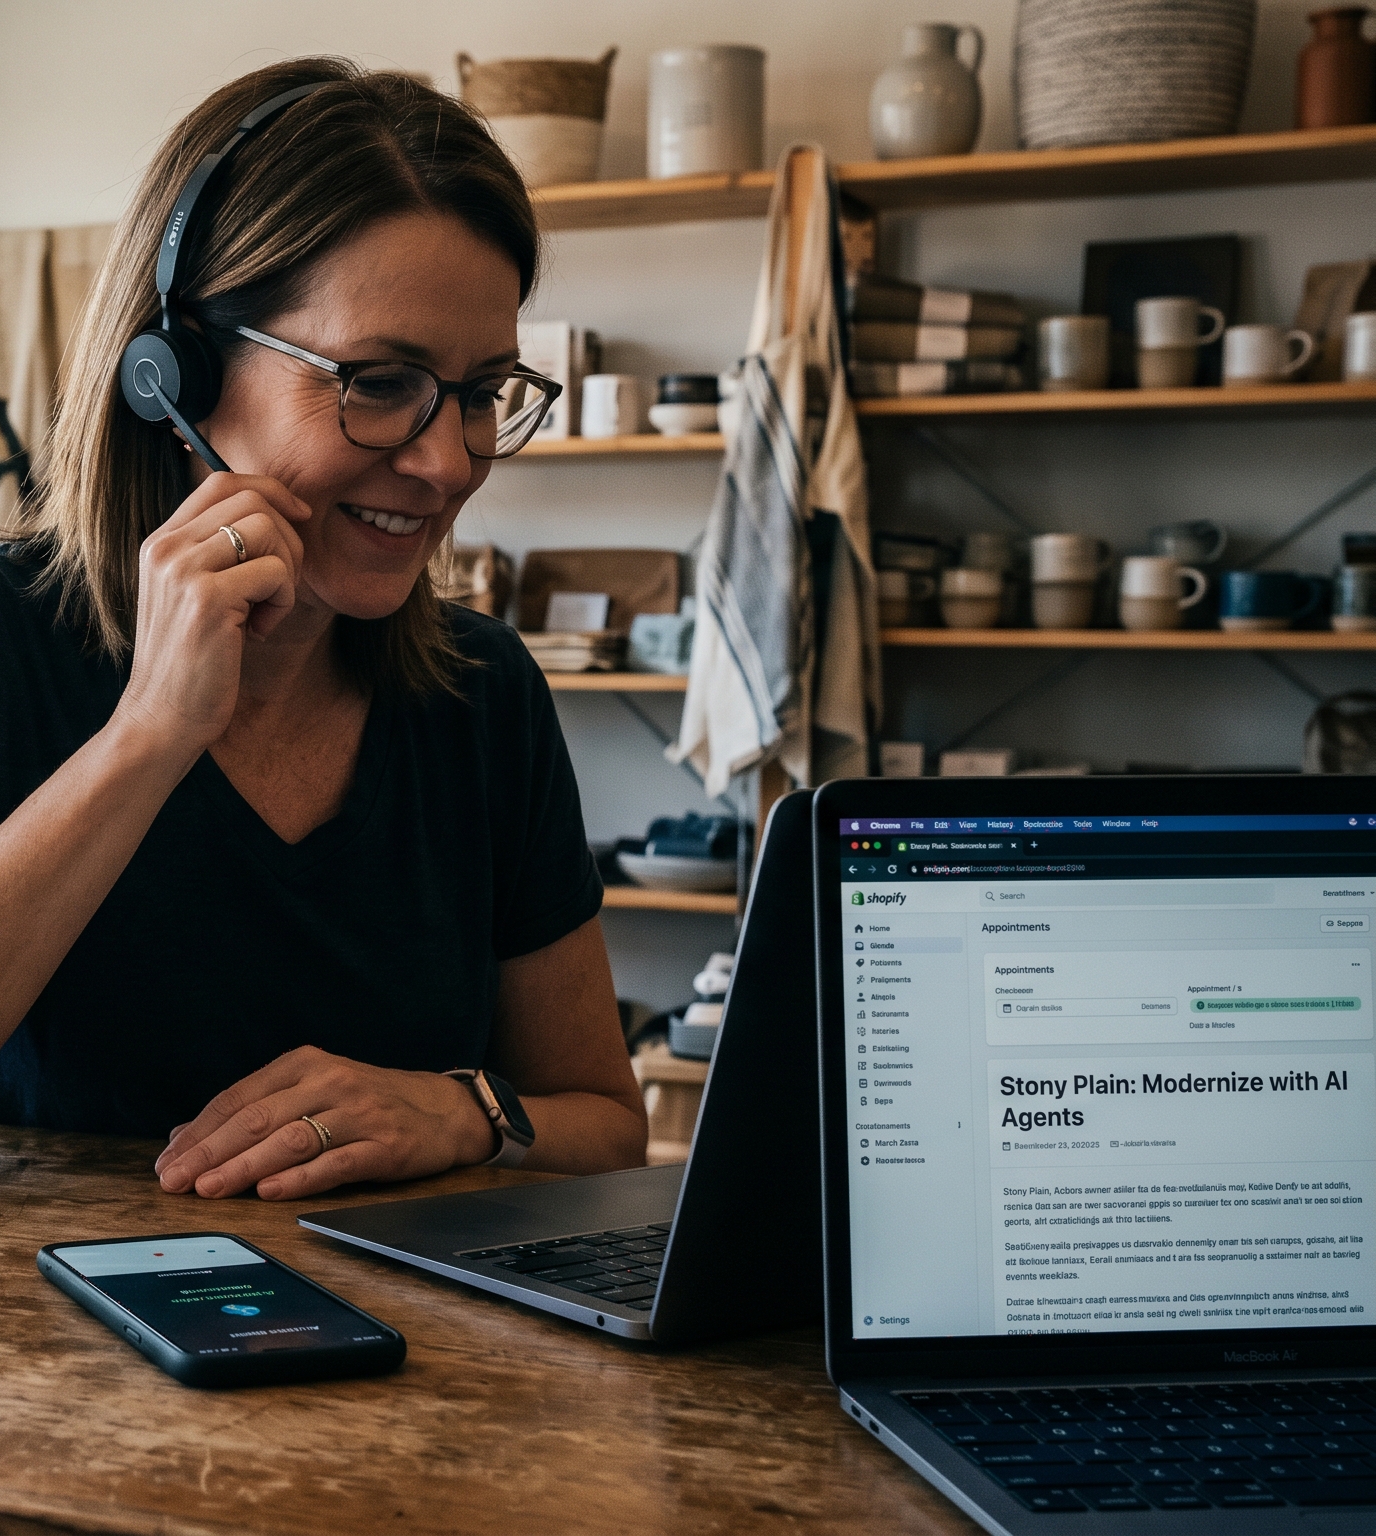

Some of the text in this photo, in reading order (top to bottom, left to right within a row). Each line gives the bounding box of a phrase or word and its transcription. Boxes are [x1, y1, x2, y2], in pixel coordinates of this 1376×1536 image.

[867, 892, 906, 905] shopify
[1000, 892, 1025, 900] Search
[982, 922, 1050, 933] Appointments
[995, 966, 1054, 975] Appointments
[1188, 985, 1231, 993] Appointment
[1000, 1070, 1348, 1099] Stony Plain: Modernize with AI
[1002, 1107, 1084, 1131] Agents
[1058, 1142, 1070, 1150] 23,
[1071, 1141, 1100, 1149] 202025
[1003, 1187, 1027, 1197] Stony
[1069, 1202, 1083, 1210] are
[1155, 1254, 1171, 1263] and
[1173, 1294, 1188, 1302] and
